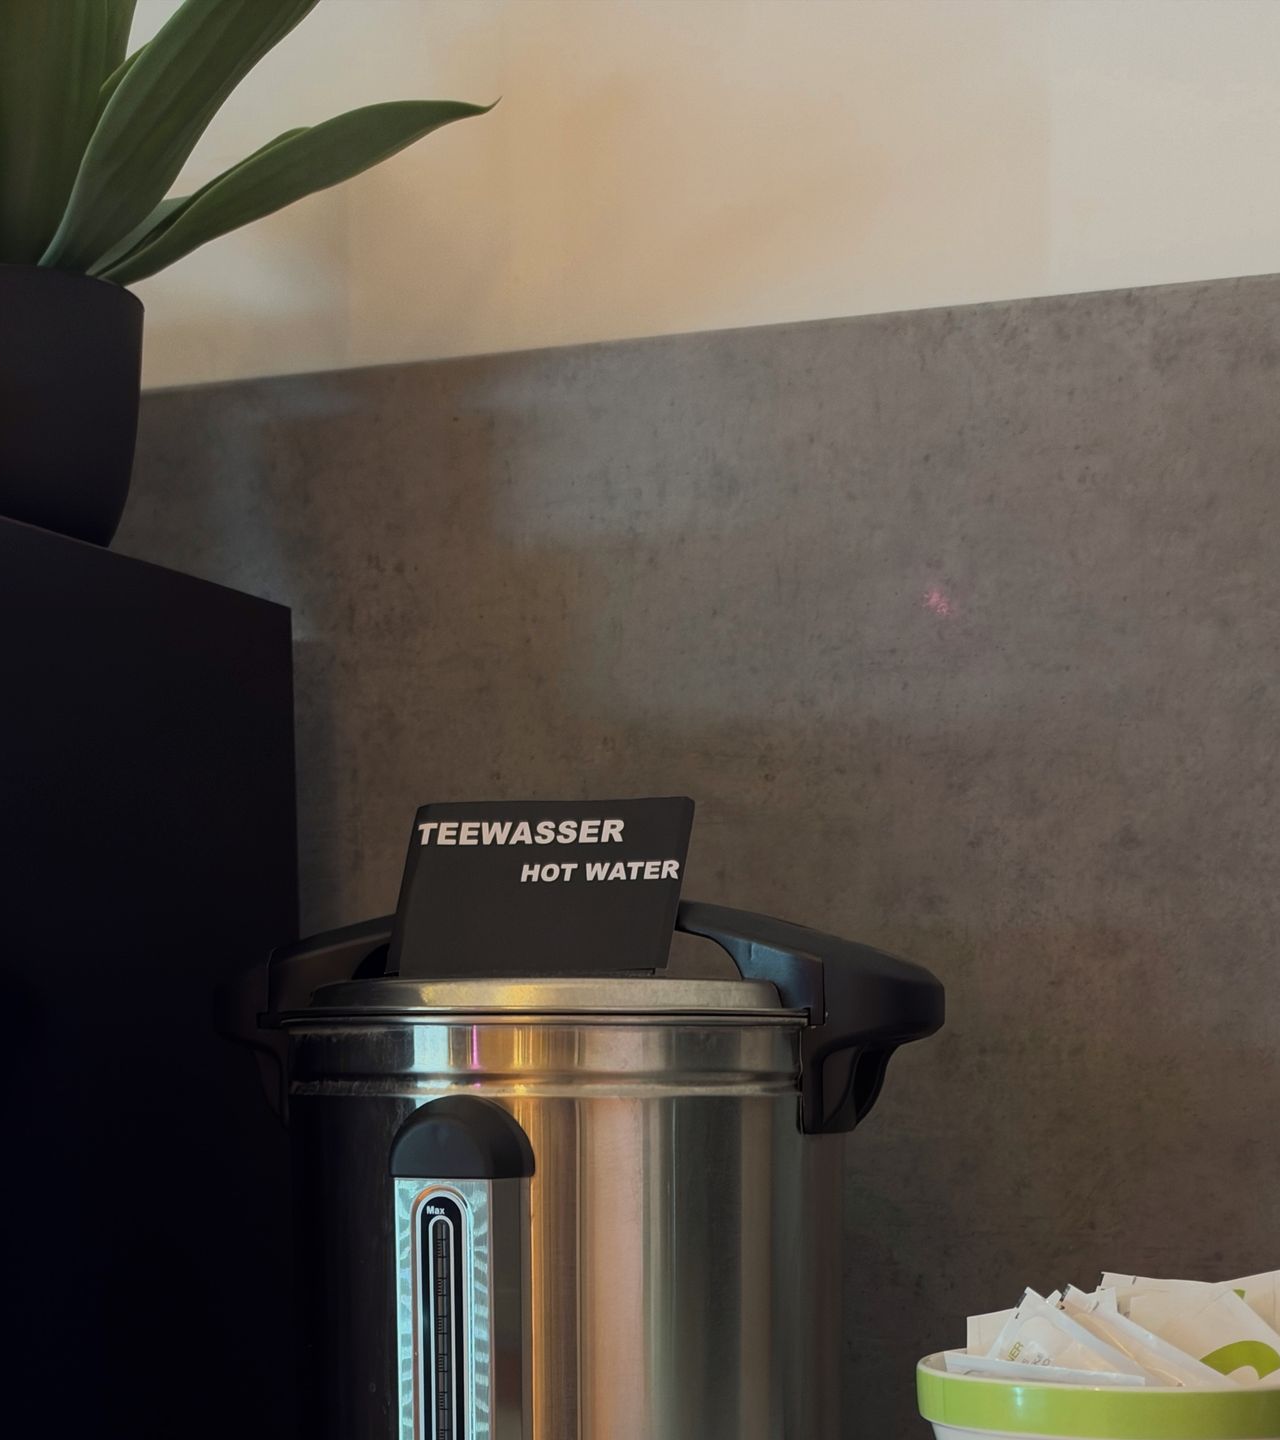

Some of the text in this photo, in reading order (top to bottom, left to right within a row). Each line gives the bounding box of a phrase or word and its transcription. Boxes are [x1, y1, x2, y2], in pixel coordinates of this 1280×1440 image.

[418, 819, 625, 846] TEEWASSER
[520, 859, 680, 883] HOT WATER
[426, 1205, 446, 1215] Max
